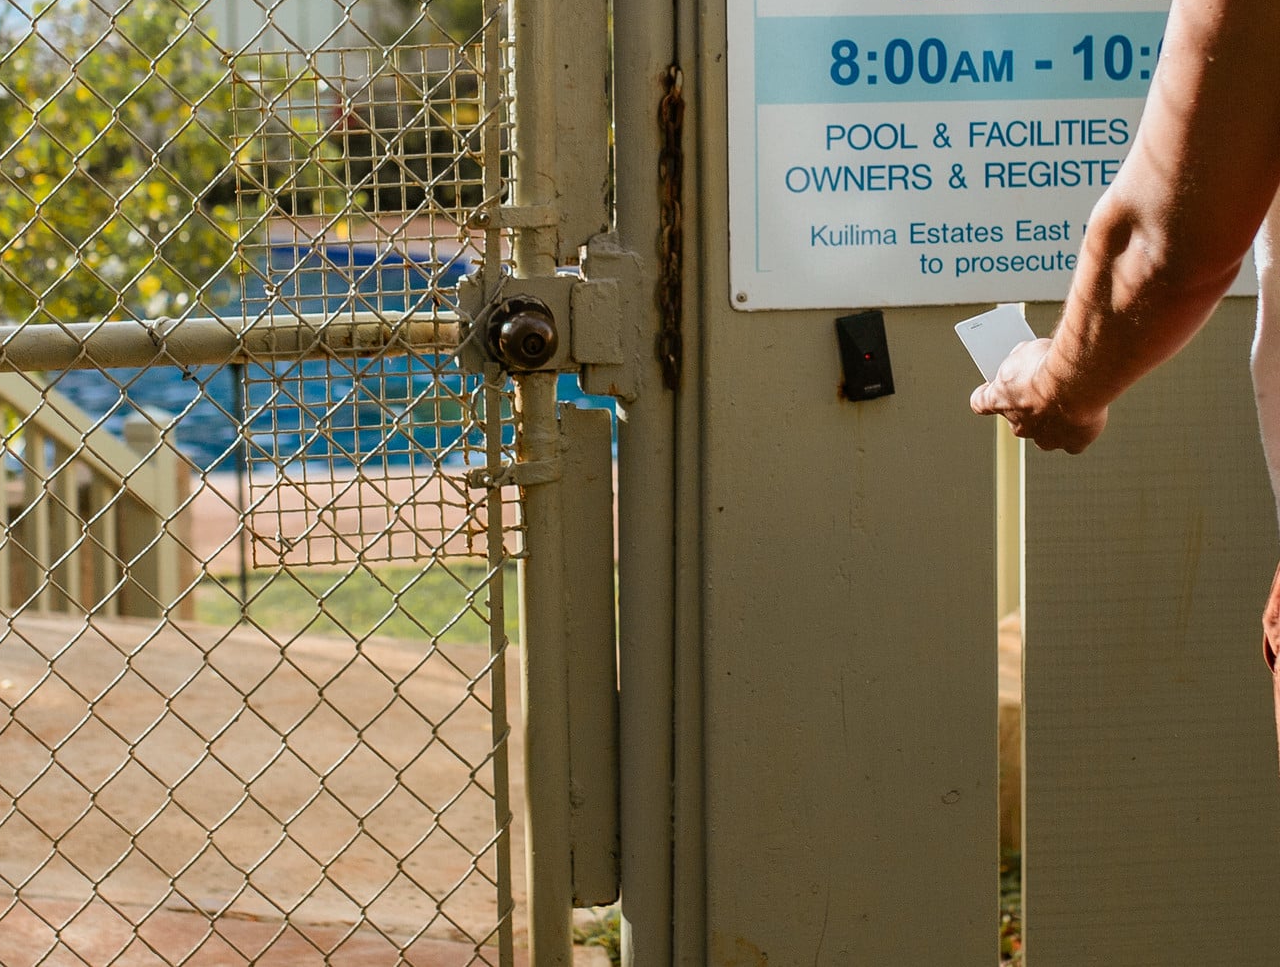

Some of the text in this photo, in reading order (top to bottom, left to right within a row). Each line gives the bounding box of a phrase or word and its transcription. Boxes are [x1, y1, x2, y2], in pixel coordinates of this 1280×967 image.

[829, 34, 1162, 86] 8:00AM - 10:
[825, 118, 1130, 152] POOL & FACILITIES
[785, 159, 1125, 194] OWNERS & REGISTE
[810, 224, 898, 247] Kuilima
[909, 222, 1004, 245] Estates
[1015, 219, 1071, 242] East
[919, 250, 1077, 278] to prosecute
